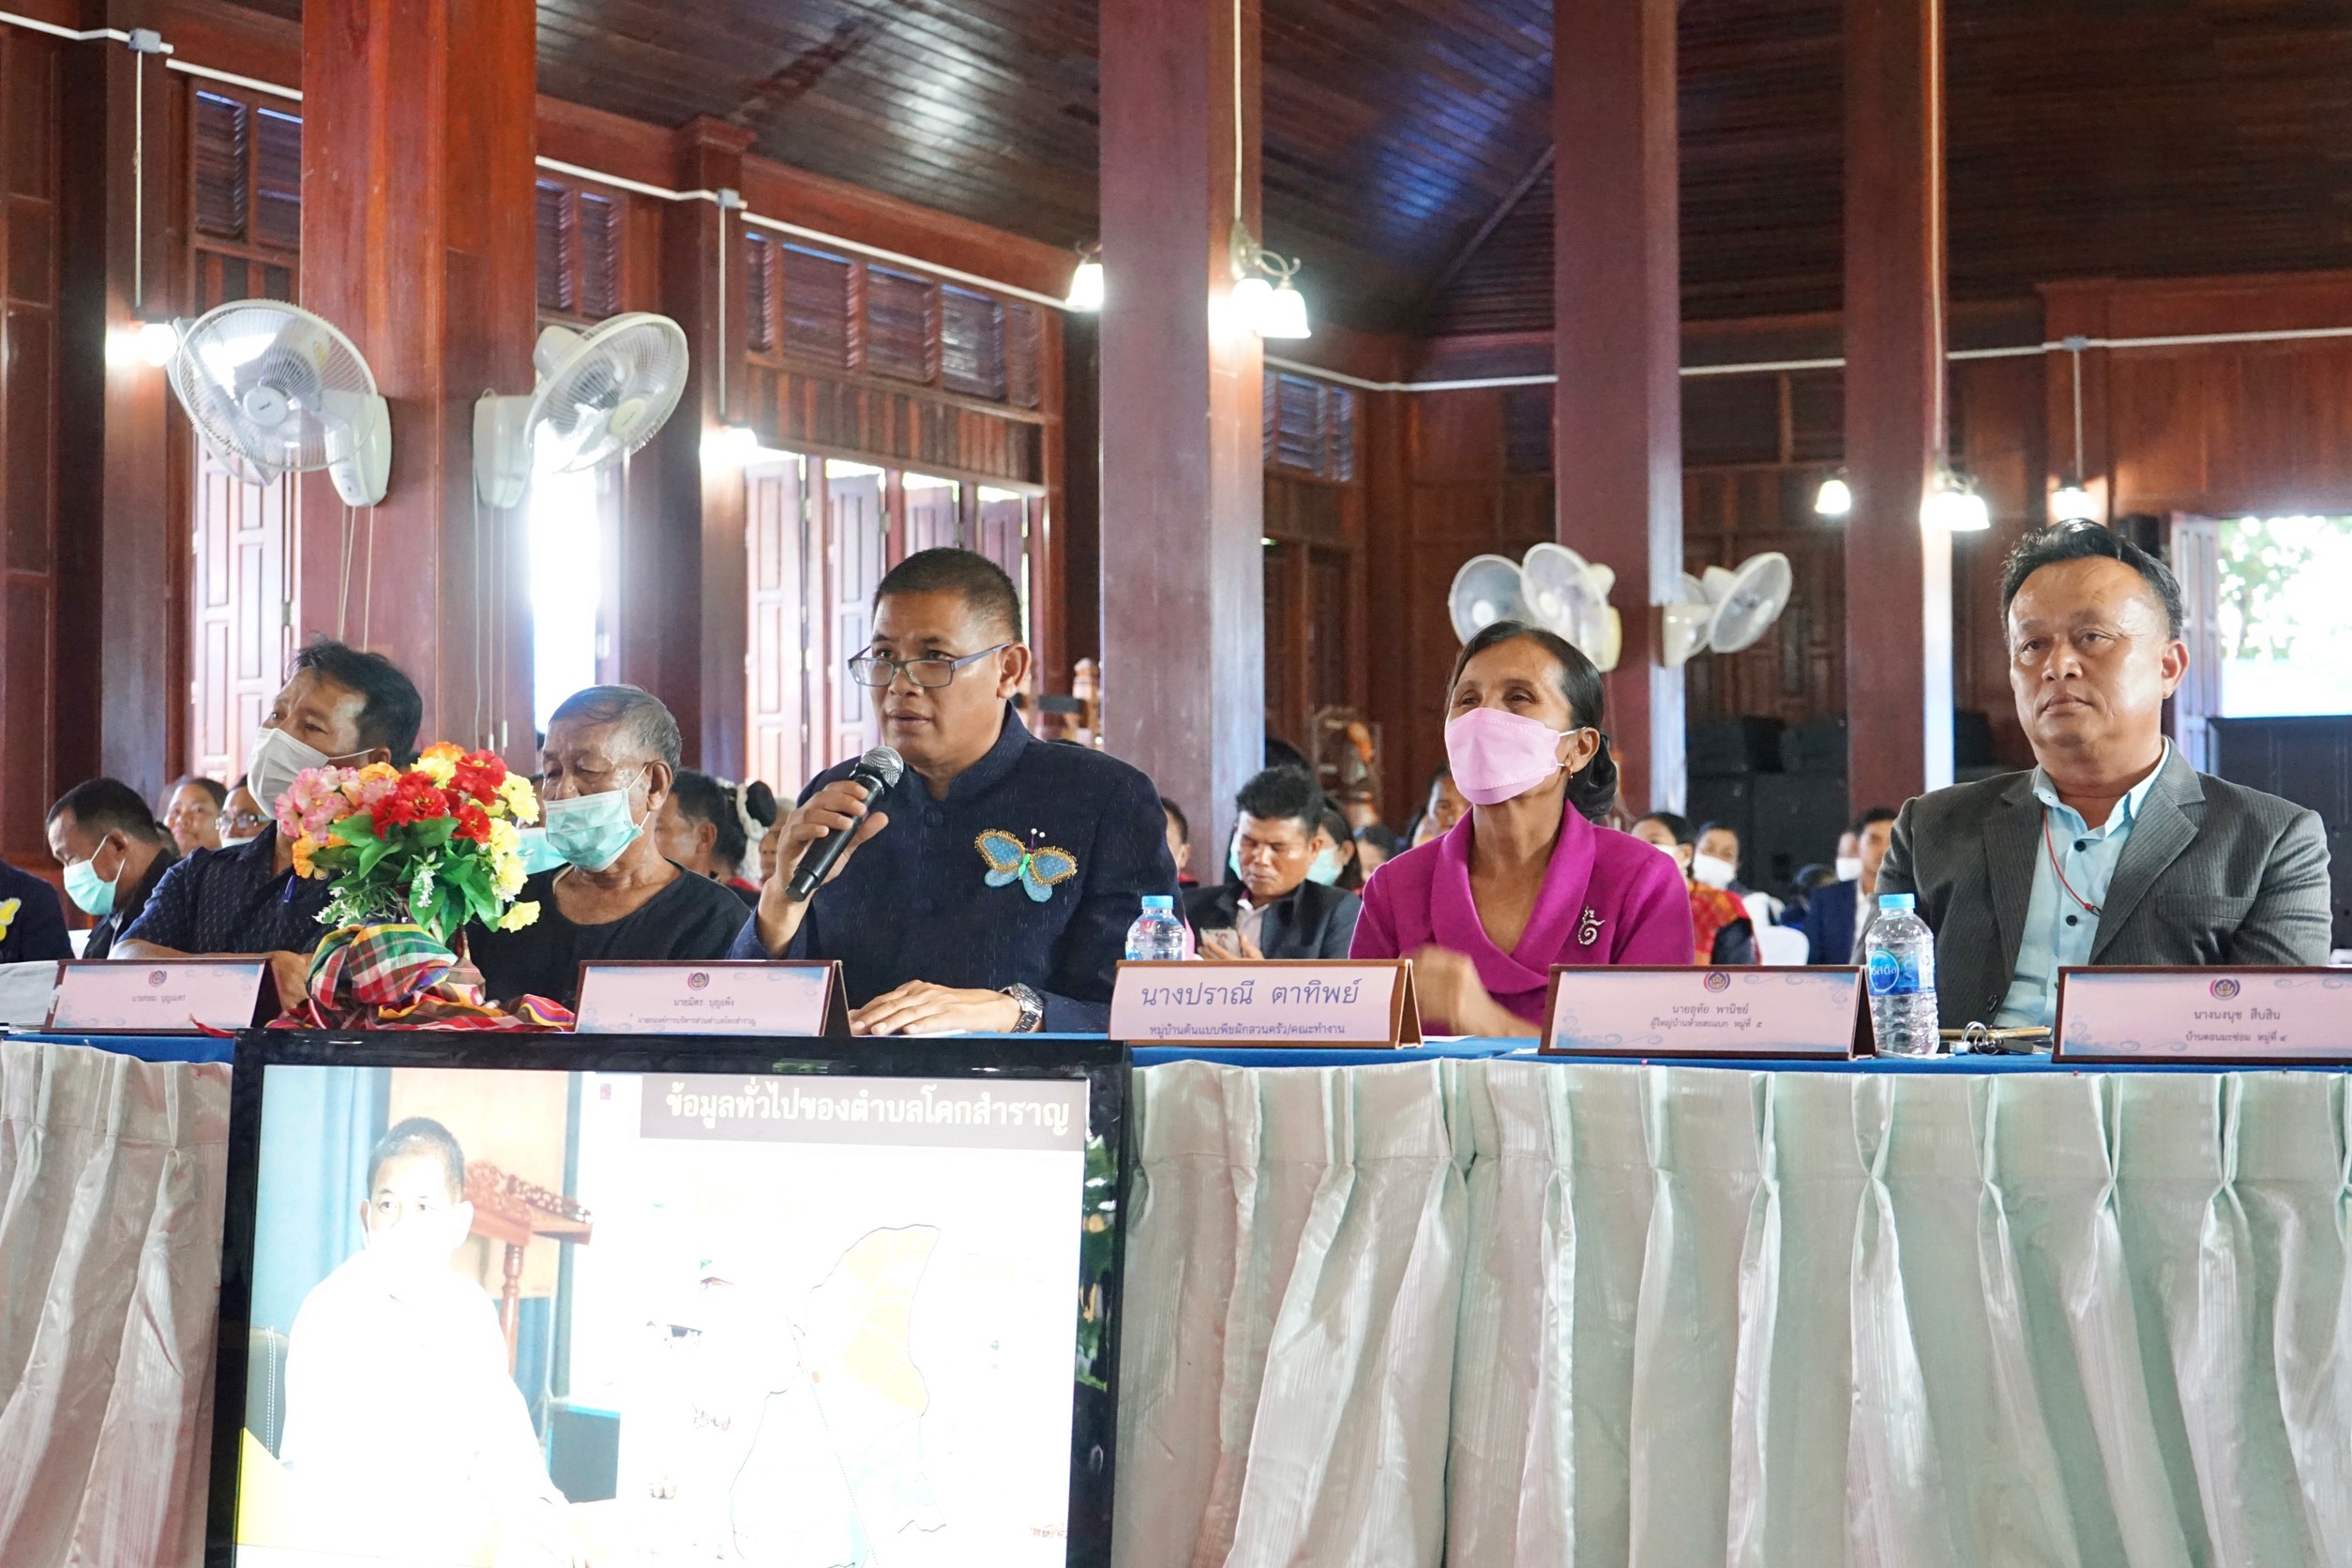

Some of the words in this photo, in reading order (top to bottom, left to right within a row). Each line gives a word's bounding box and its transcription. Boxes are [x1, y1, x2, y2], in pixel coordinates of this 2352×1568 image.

[1141, 979, 1256, 1006] นางปราณี
[1272, 977, 1363, 1005] ตาทิพย์
[1672, 1003, 1710, 1018] นายอุทัย
[1716, 1002, 1749, 1015] พานิชย์
[2194, 1010, 2242, 1024] นางนงนุช
[1150, 1021, 1346, 1039] หมู่บ้านต้นแบบพืชผักสวนครัว/คณะทำงาน
[665, 1076, 1070, 1137] ข้อมูลทั่วไปของตำบลโคกสำราญ
